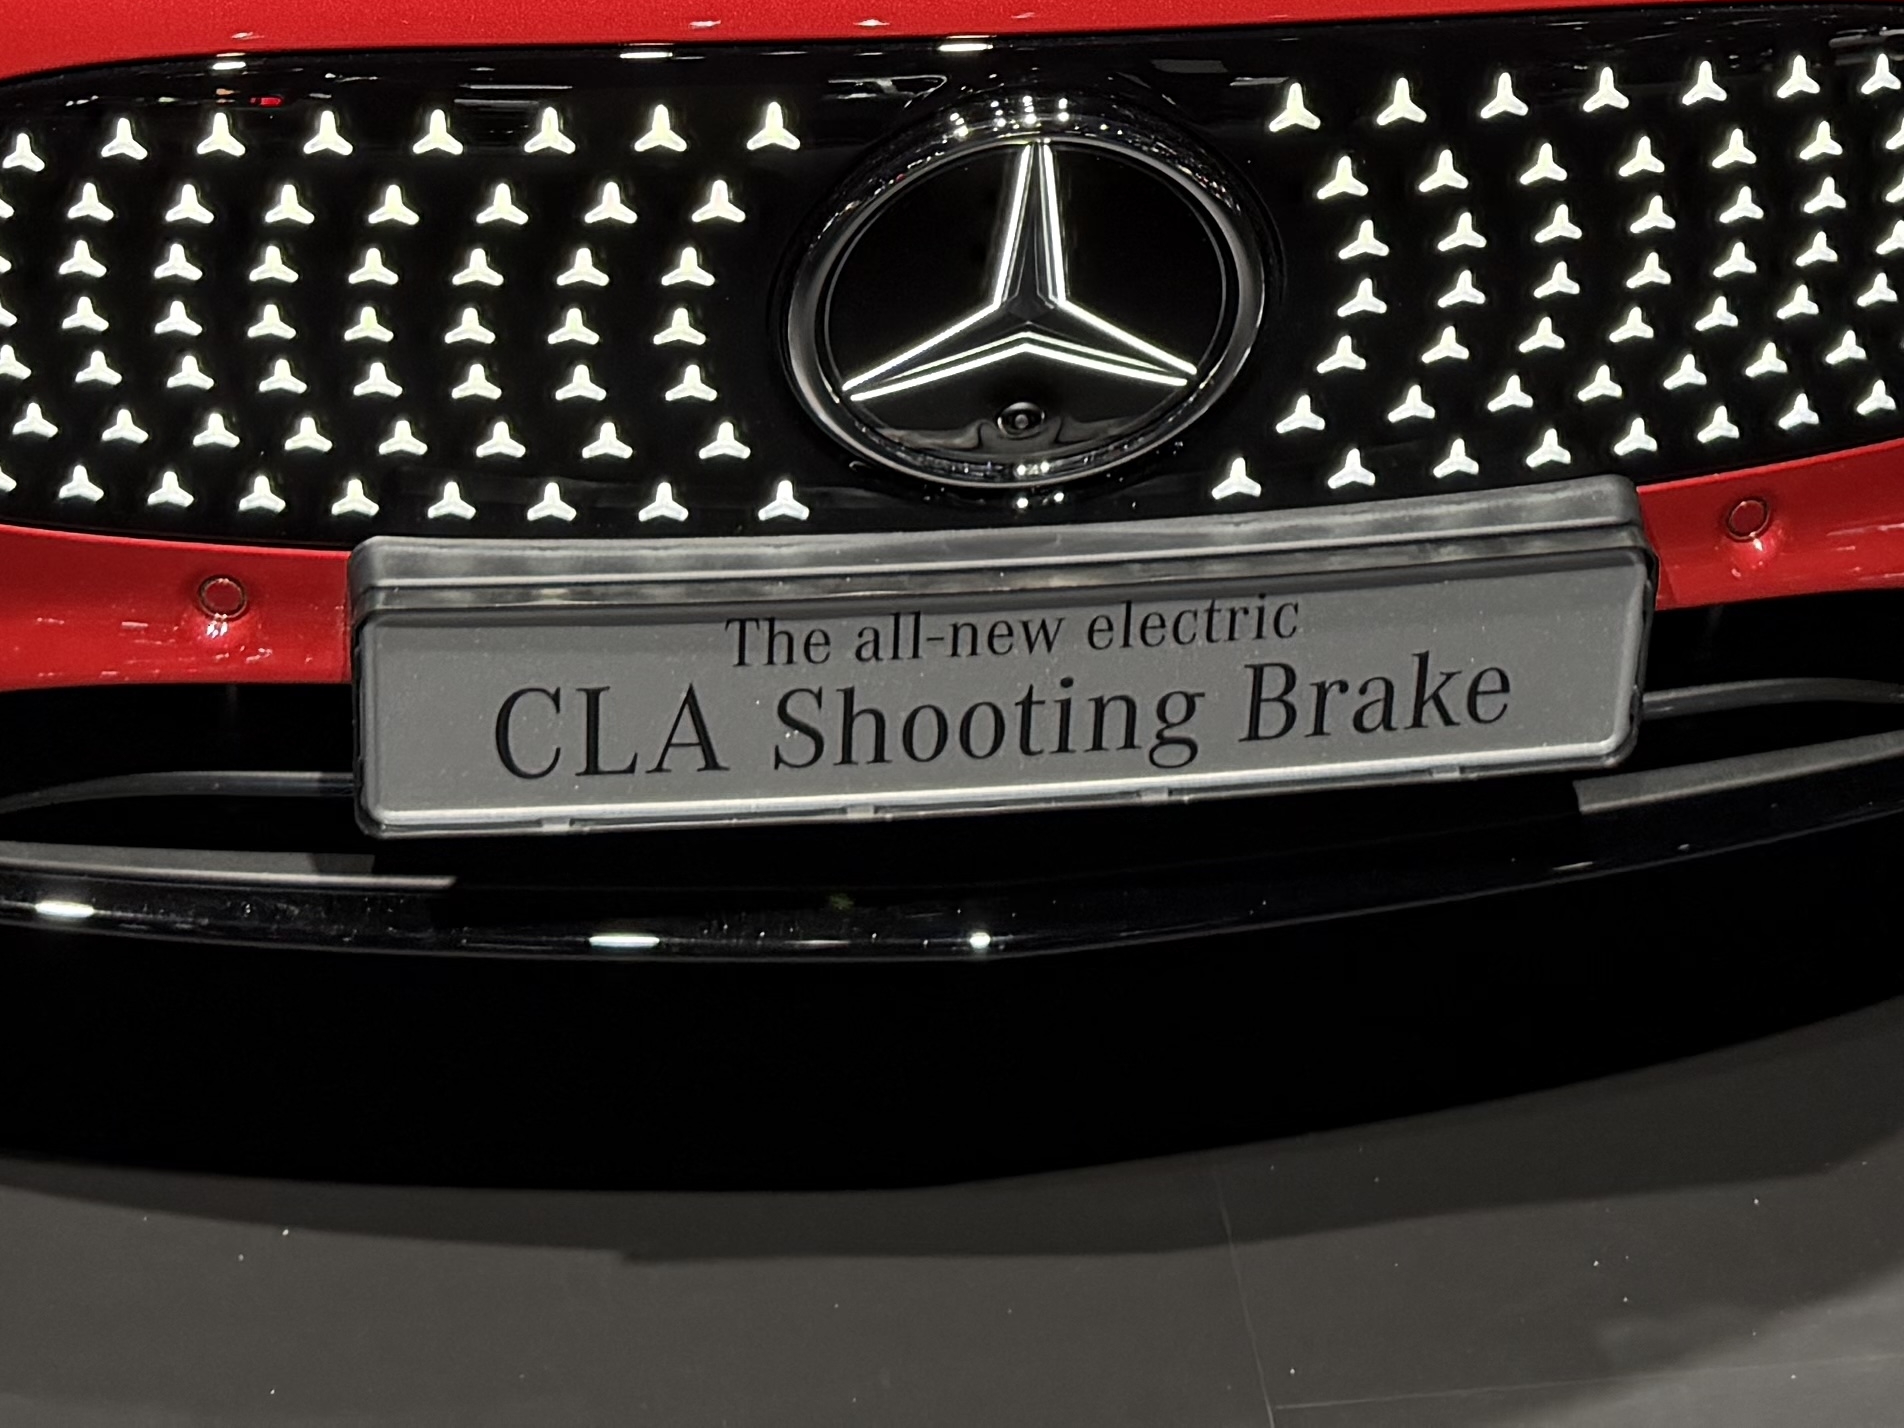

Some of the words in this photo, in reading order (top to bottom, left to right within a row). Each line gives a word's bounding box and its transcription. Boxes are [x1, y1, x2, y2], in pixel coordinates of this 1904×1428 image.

[728, 614, 836, 669] The
[856, 606, 1065, 662] all-new
[1087, 594, 1299, 648] electric
[496, 684, 729, 781] CLA
[774, 674, 1204, 771] Shooting
[1240, 650, 1512, 748] Brake
